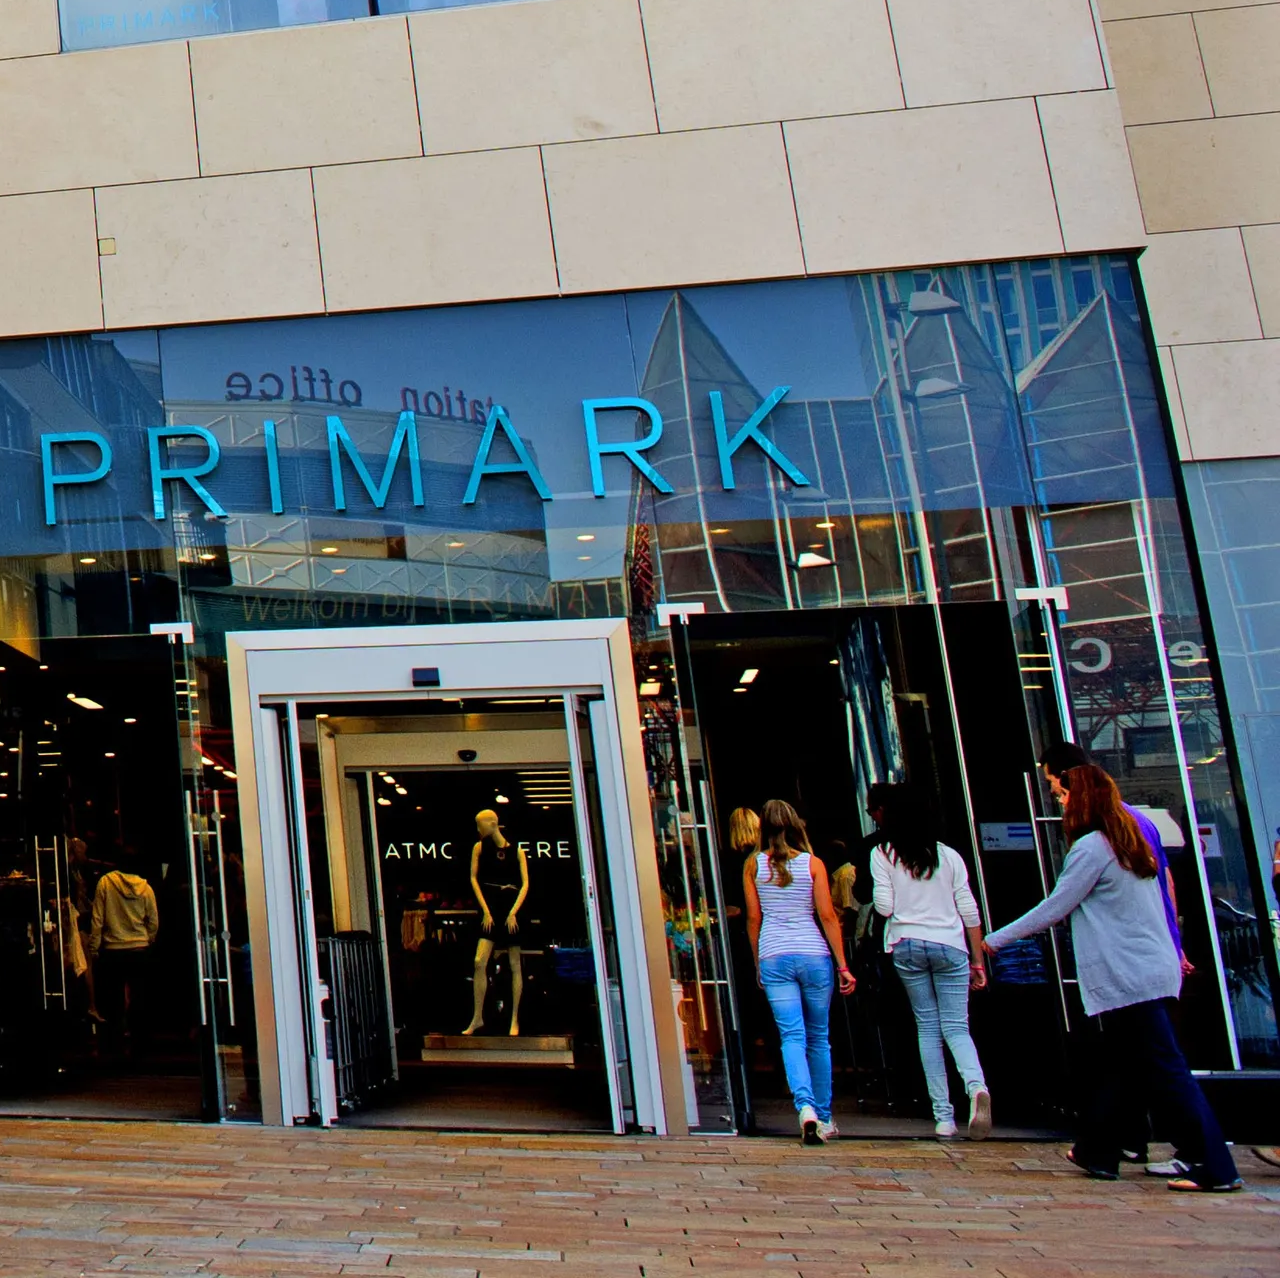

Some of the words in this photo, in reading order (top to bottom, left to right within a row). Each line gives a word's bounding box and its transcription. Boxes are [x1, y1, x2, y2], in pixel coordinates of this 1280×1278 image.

[40, 385, 810, 525] PRIMARK
[242, 591, 369, 623] Welkom
[385, 841, 571, 859] ATMOERE
